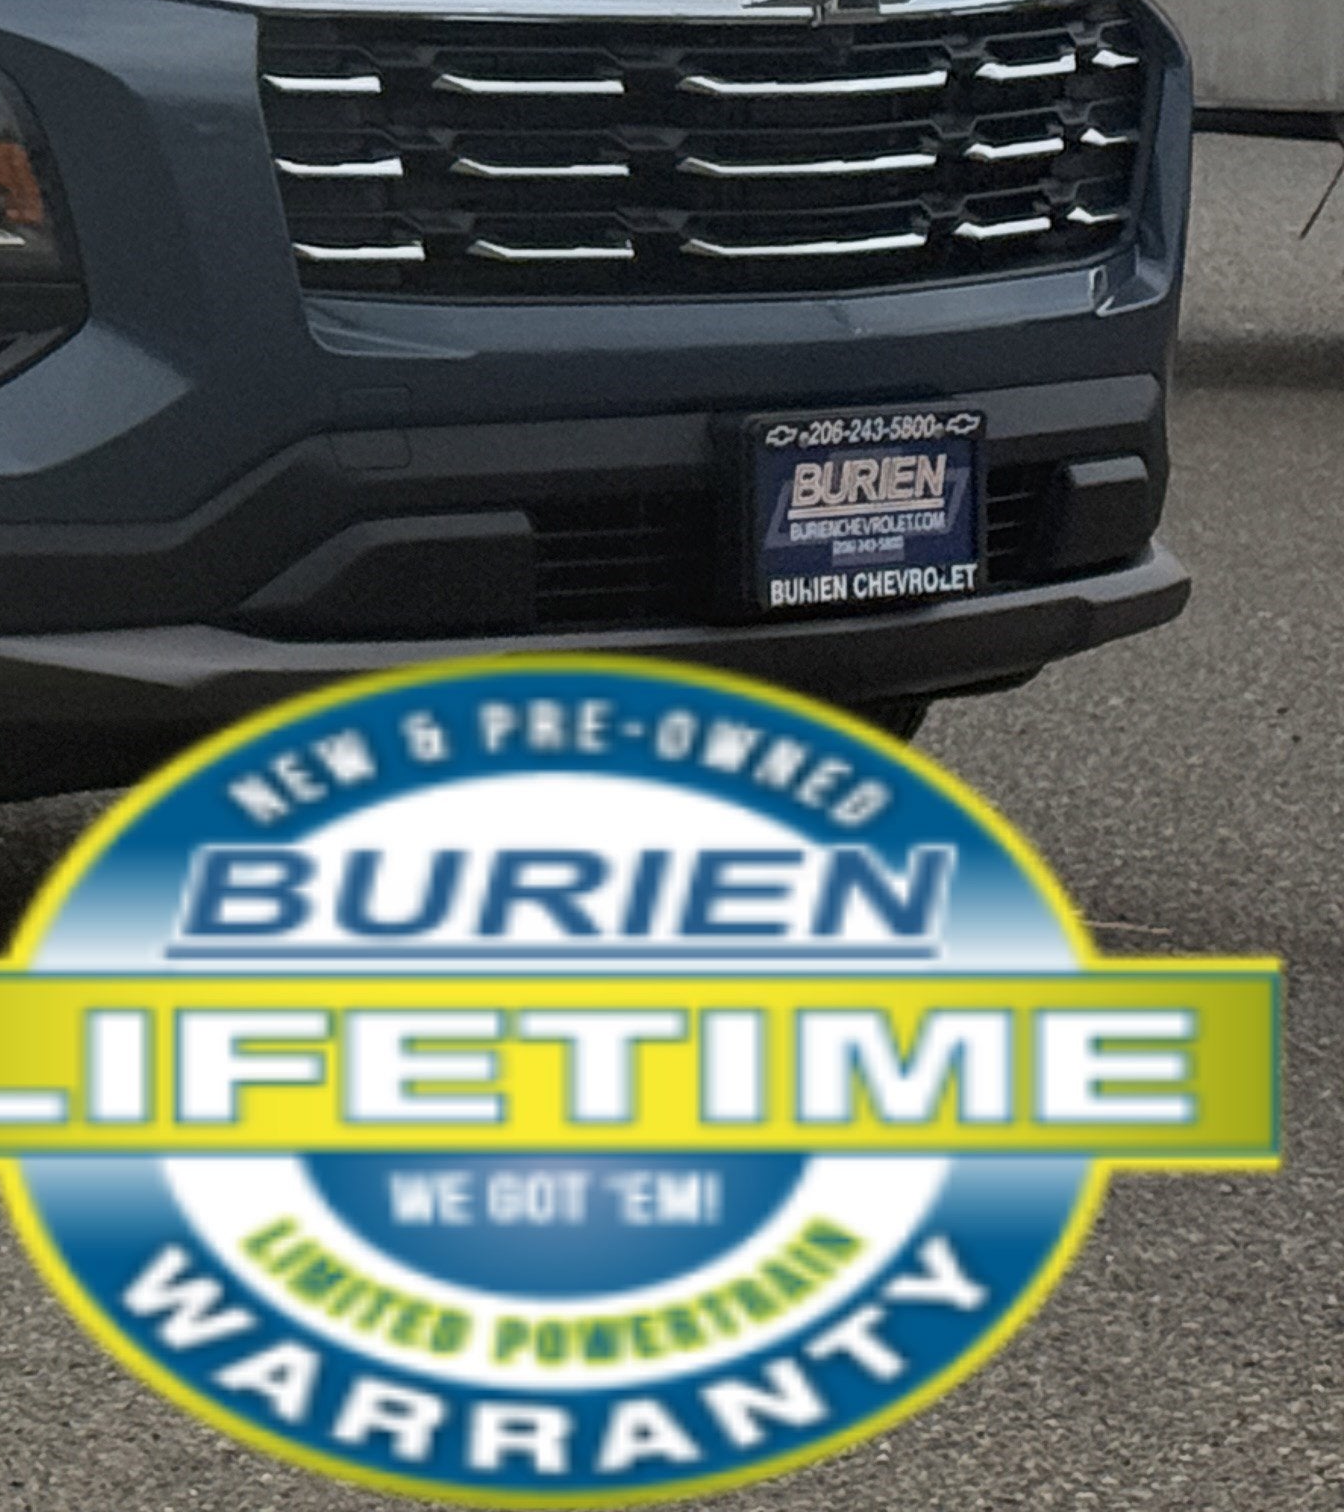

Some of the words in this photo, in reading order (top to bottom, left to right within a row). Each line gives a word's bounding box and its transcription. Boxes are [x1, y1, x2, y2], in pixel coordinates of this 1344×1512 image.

[809, 413, 937, 445] 206-243-5800
[792, 454, 947, 507] BURIEN
[853, 563, 978, 599] CHEVROLET
